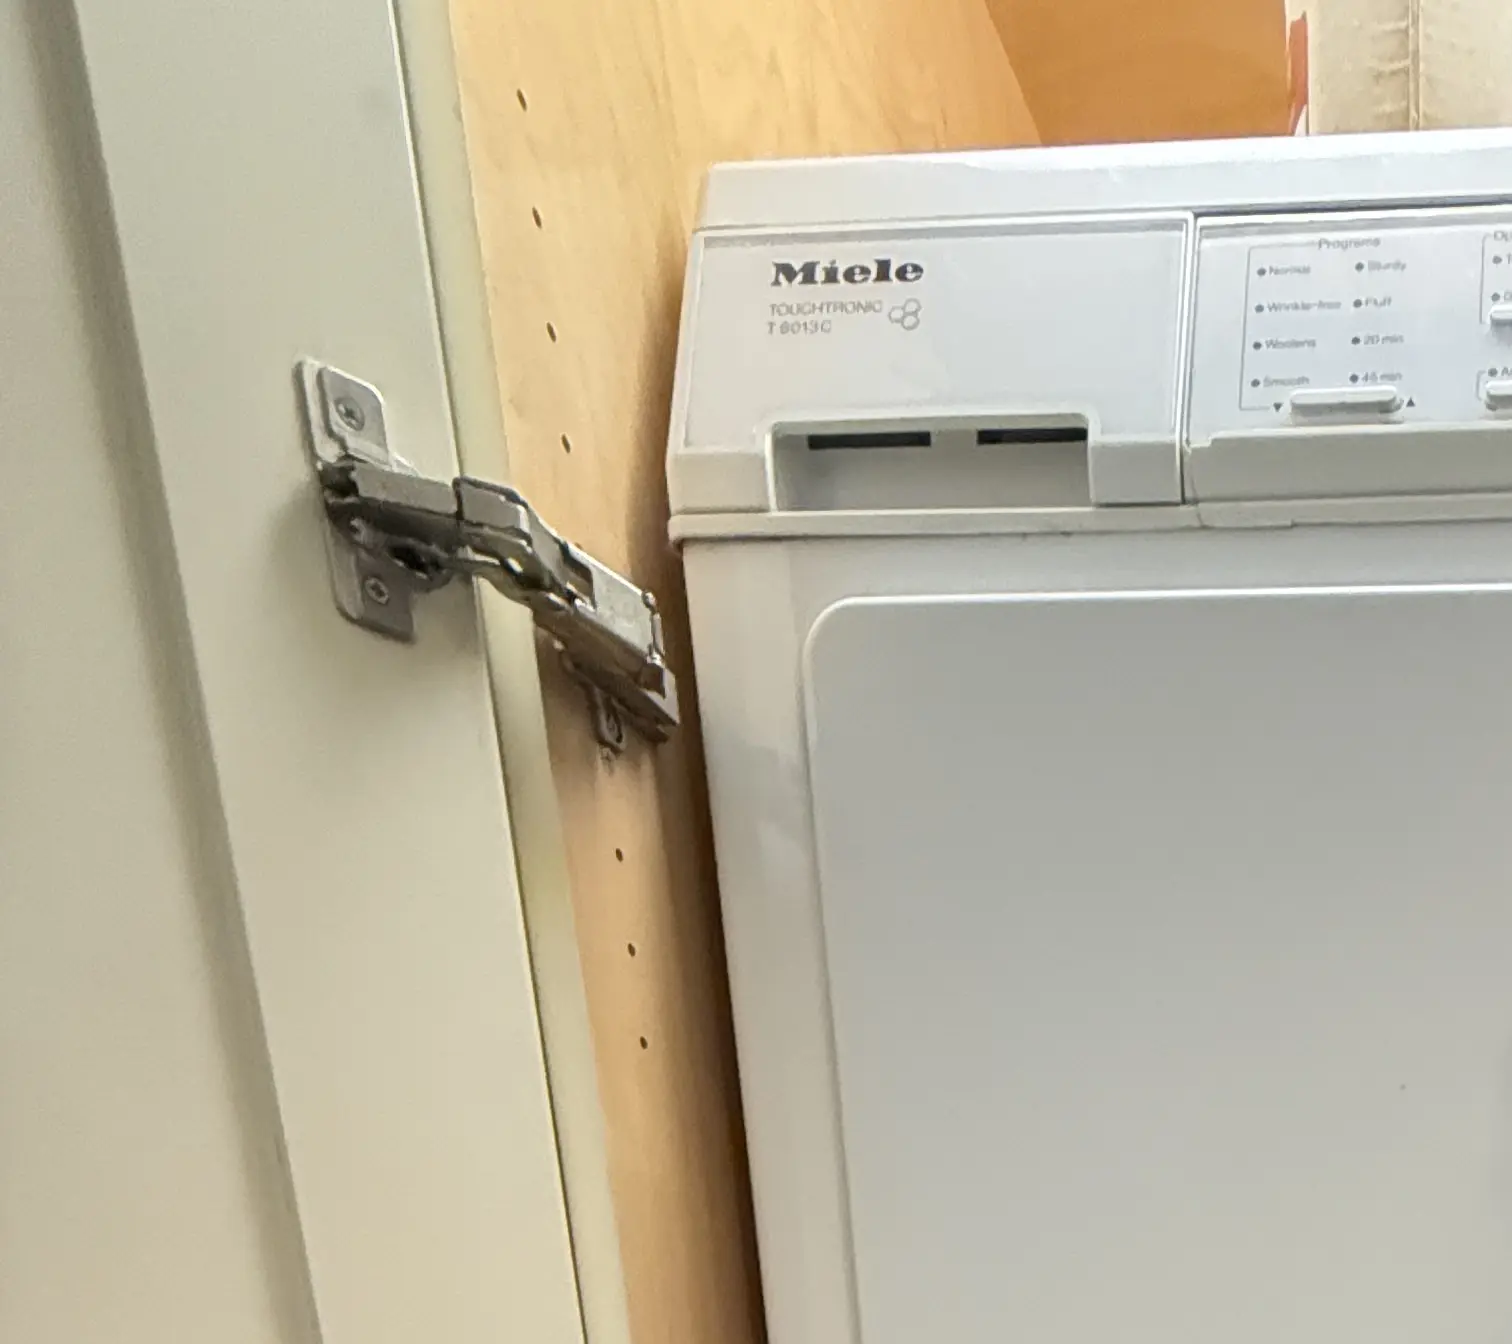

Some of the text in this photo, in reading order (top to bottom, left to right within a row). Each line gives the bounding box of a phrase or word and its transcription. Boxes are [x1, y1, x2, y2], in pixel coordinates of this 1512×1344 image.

[1318, 238, 1381, 251] Programs
[771, 258, 924, 287] Miele
[769, 300, 883, 316] TOUCHTRONIC
